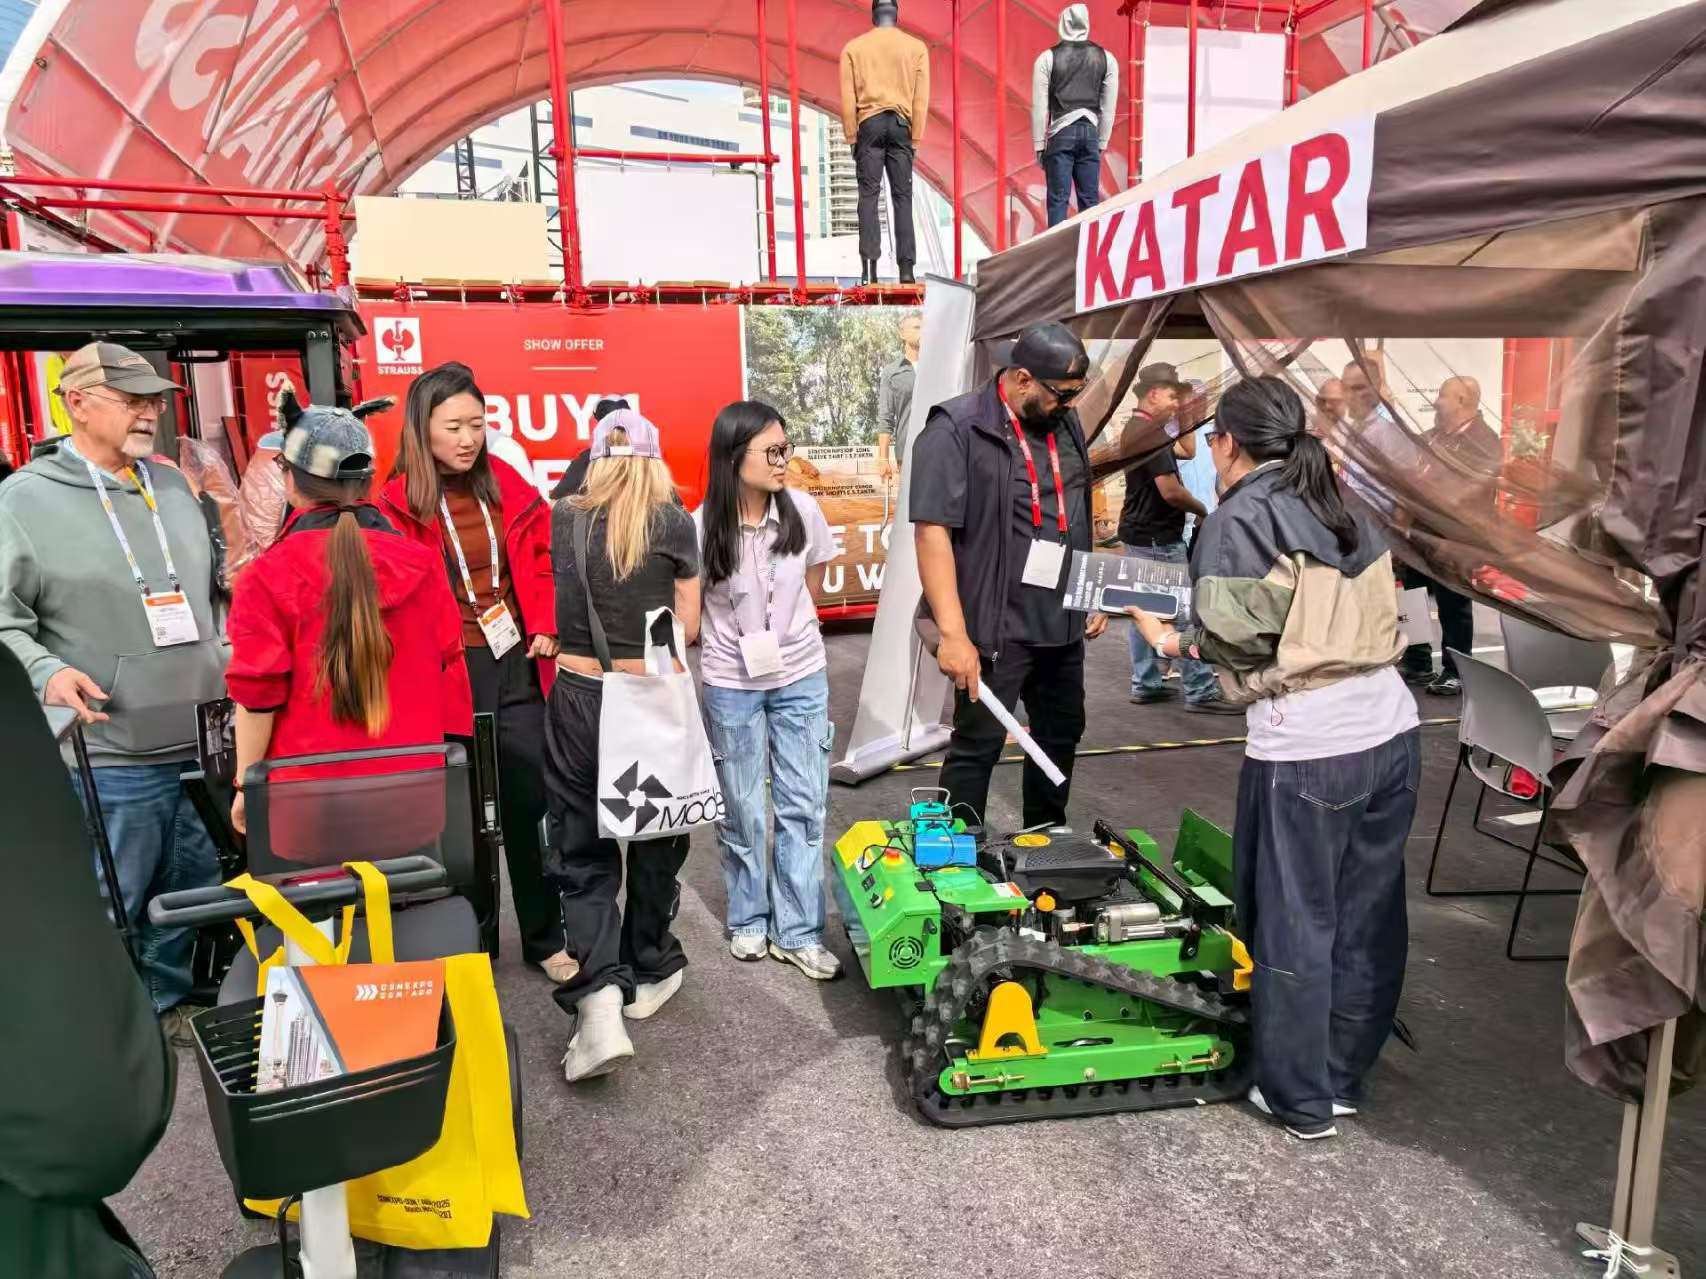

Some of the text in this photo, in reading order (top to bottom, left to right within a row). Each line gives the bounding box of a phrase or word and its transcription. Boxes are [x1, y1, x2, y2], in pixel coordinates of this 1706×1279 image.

[1085, 133, 1350, 307] KATAR
[524, 339, 604, 351] SHOW OFFER
